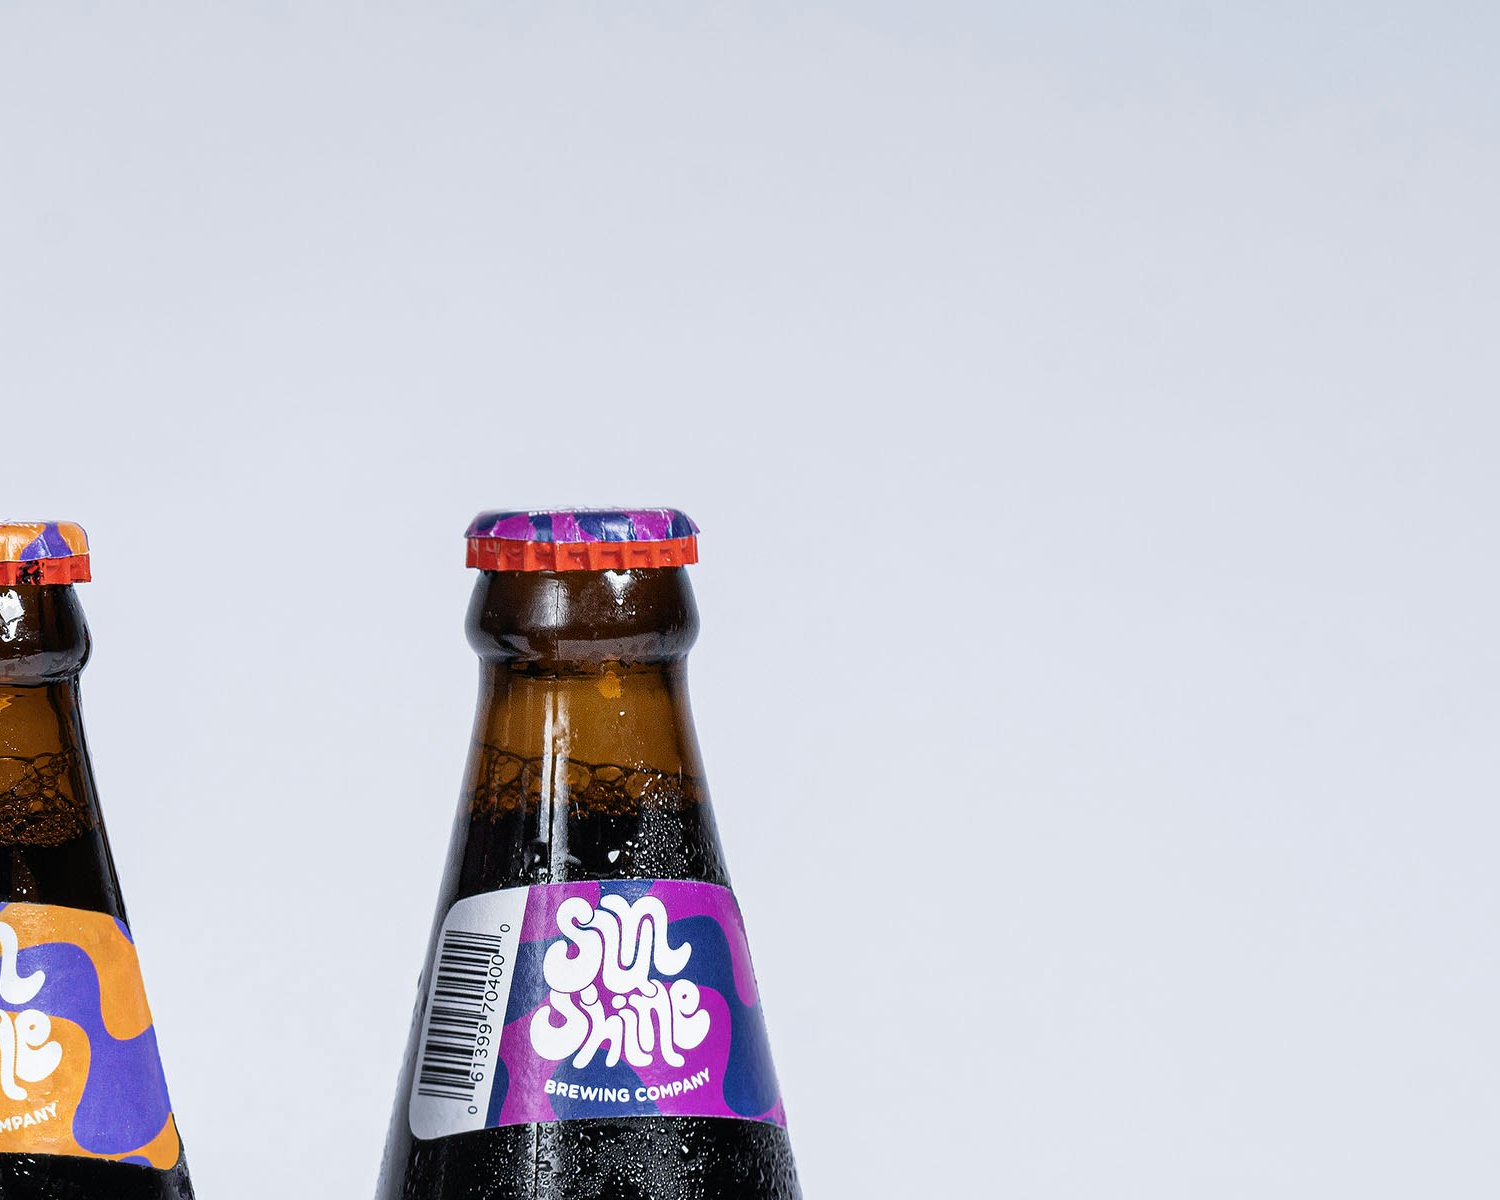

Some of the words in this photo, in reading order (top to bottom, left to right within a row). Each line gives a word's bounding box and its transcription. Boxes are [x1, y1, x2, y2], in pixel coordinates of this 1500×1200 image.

[500, 923, 511, 933] 0
[482, 954, 505, 1013] 70400
[471, 1024, 492, 1082] 61399
[544, 1079, 630, 1103] BREWING
[635, 1067, 710, 1102] COMPANY
[467, 1106, 478, 1115] 0
